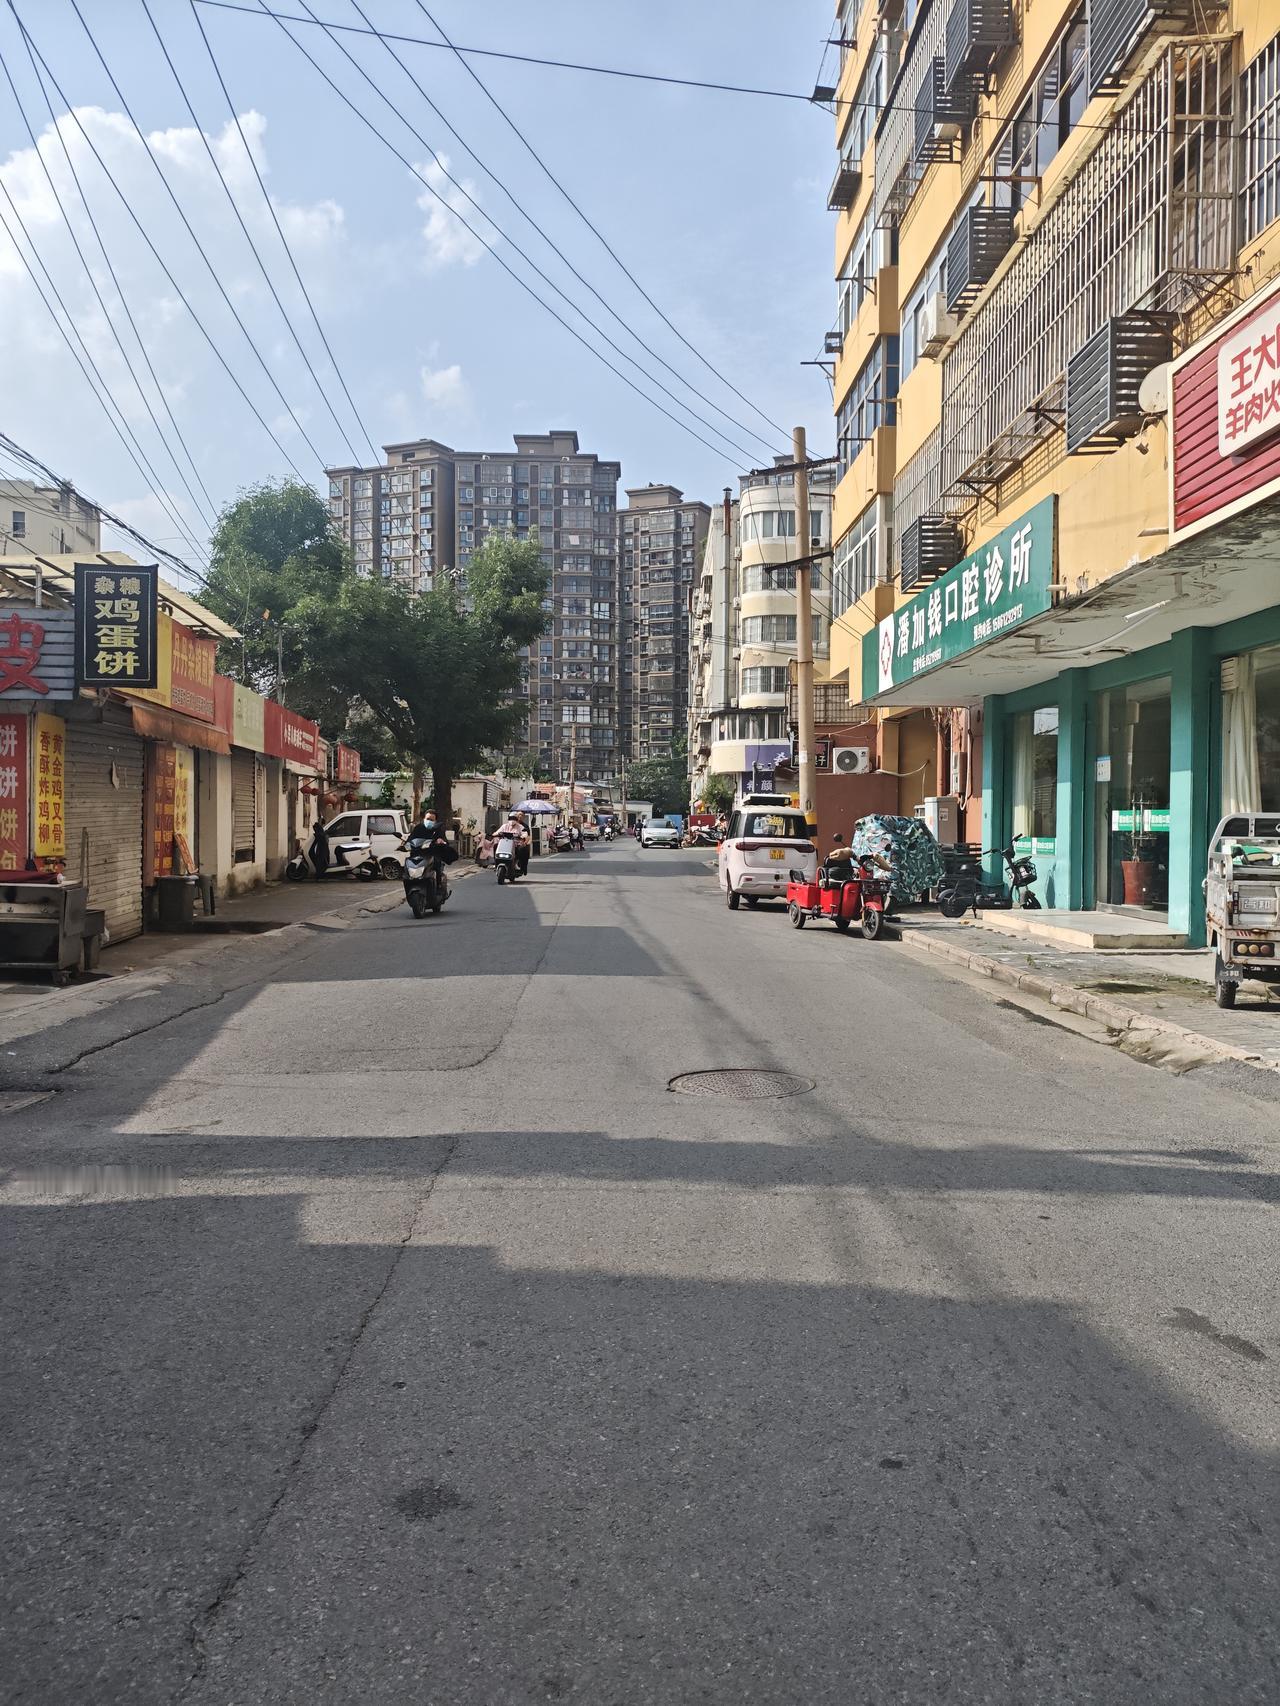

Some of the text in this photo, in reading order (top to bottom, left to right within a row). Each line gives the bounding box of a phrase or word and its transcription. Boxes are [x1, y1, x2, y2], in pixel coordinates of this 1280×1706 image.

[1231, 322, 1280, 399] 王大
[95, 575, 141, 595] 杂粮
[897, 522, 1032, 658] 潘加钱口腔诊所
[93, 598, 141, 676] 鸡蛋饼
[38, 731, 51, 845] 香酥炸鸡柳
[51, 733, 64, 845] 黄金鸡叉骨
